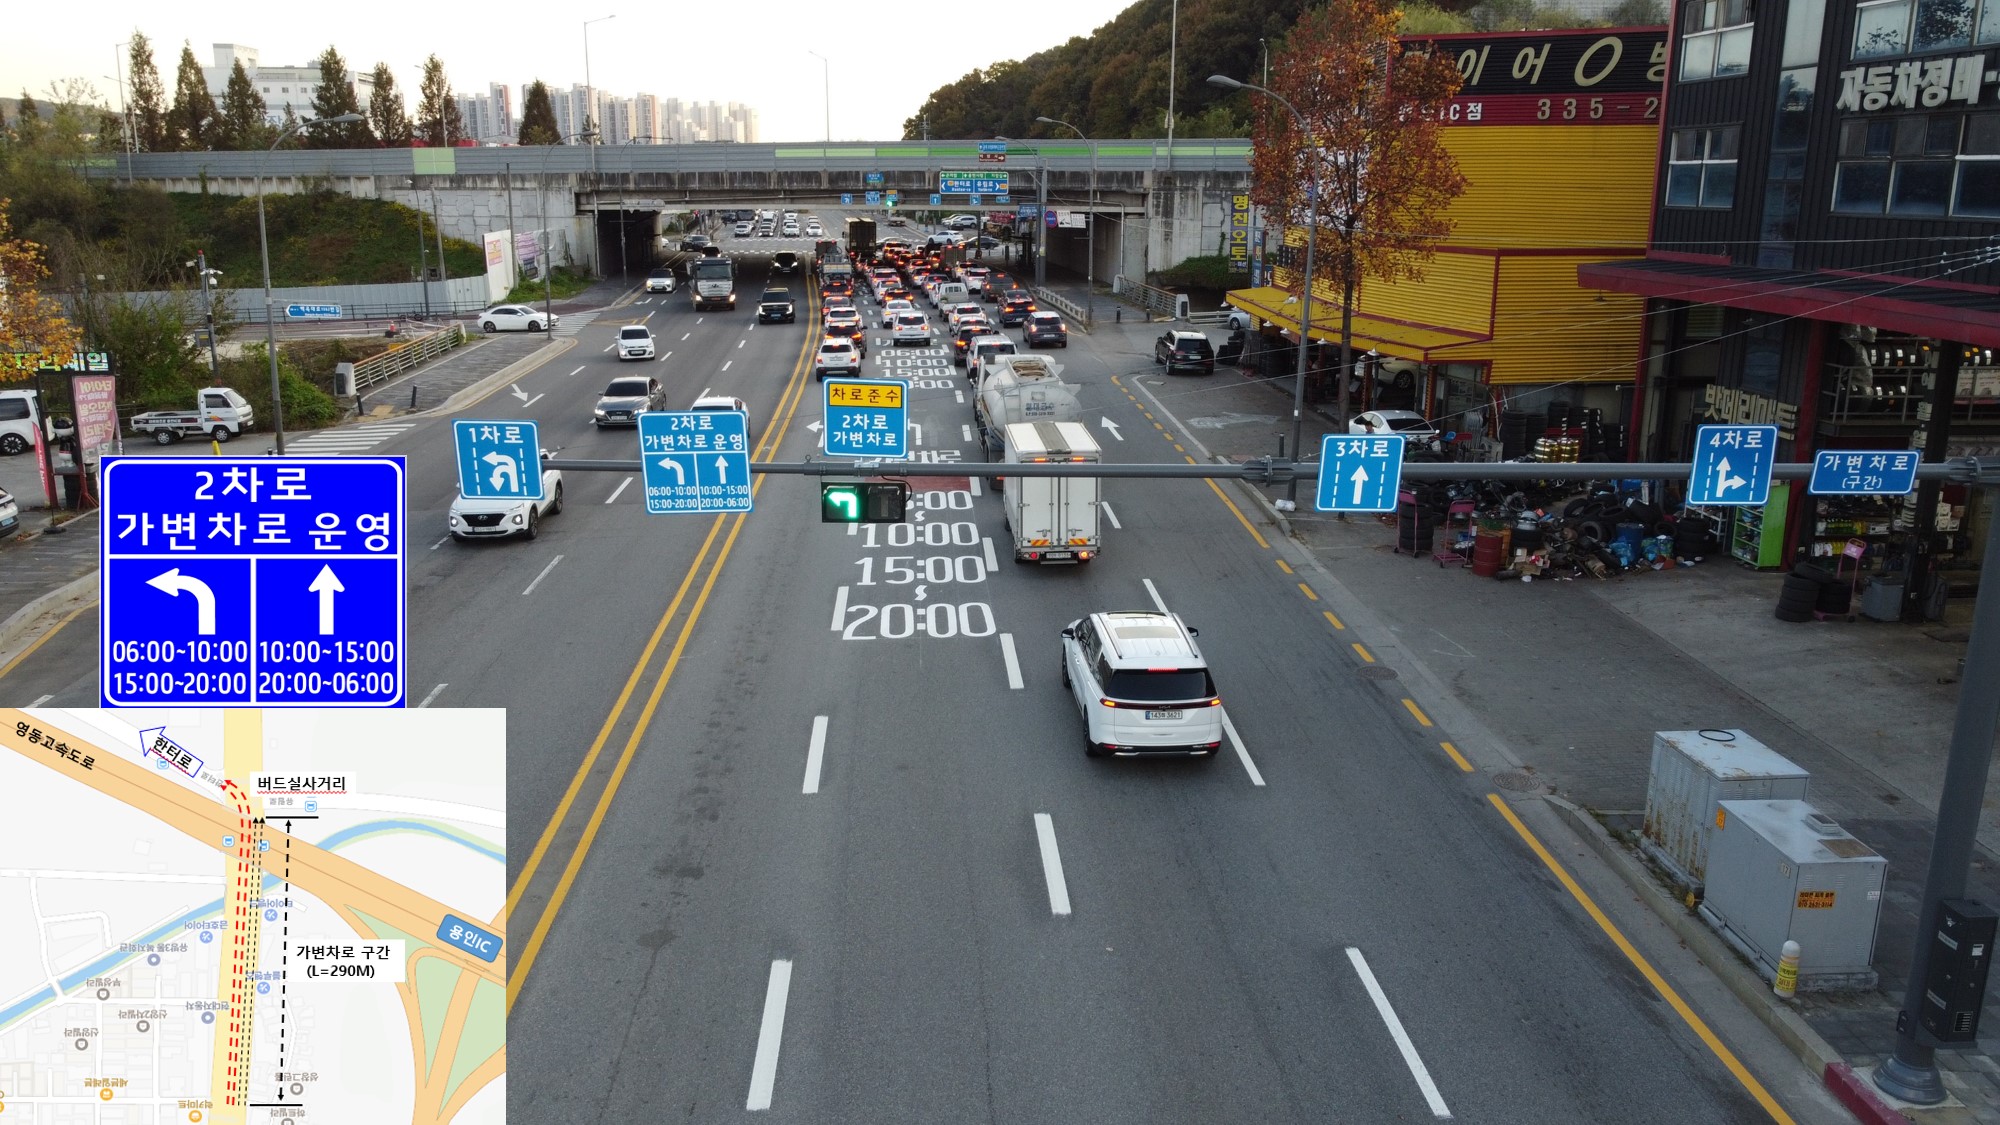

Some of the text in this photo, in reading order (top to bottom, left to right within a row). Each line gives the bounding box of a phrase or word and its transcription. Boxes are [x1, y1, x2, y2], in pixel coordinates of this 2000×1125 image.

[1230, 195, 1249, 261] 명진오토
[881, 349, 945, 357] 06:00
[882, 358, 947, 367] 10:00
[882, 367, 950, 377] 15:00
[832, 387, 900, 403] 차로준수
[671, 415, 714, 431] 2차로
[842, 413, 888, 430] 2차로
[468, 425, 524, 444] 1차로
[645, 434, 743, 451] 가변차로 운영
[833, 431, 897, 448] 가변차로
[1710, 430, 1763, 449] 4차로
[1336, 440, 1389, 458] 3차로
[1824, 455, 1908, 474] 가변차로
[1842, 476, 1882, 490] (구간)
[860, 522, 980, 547] 10:00
[854, 555, 987, 585] 15:00
[842, 602, 997, 640] 20:00
